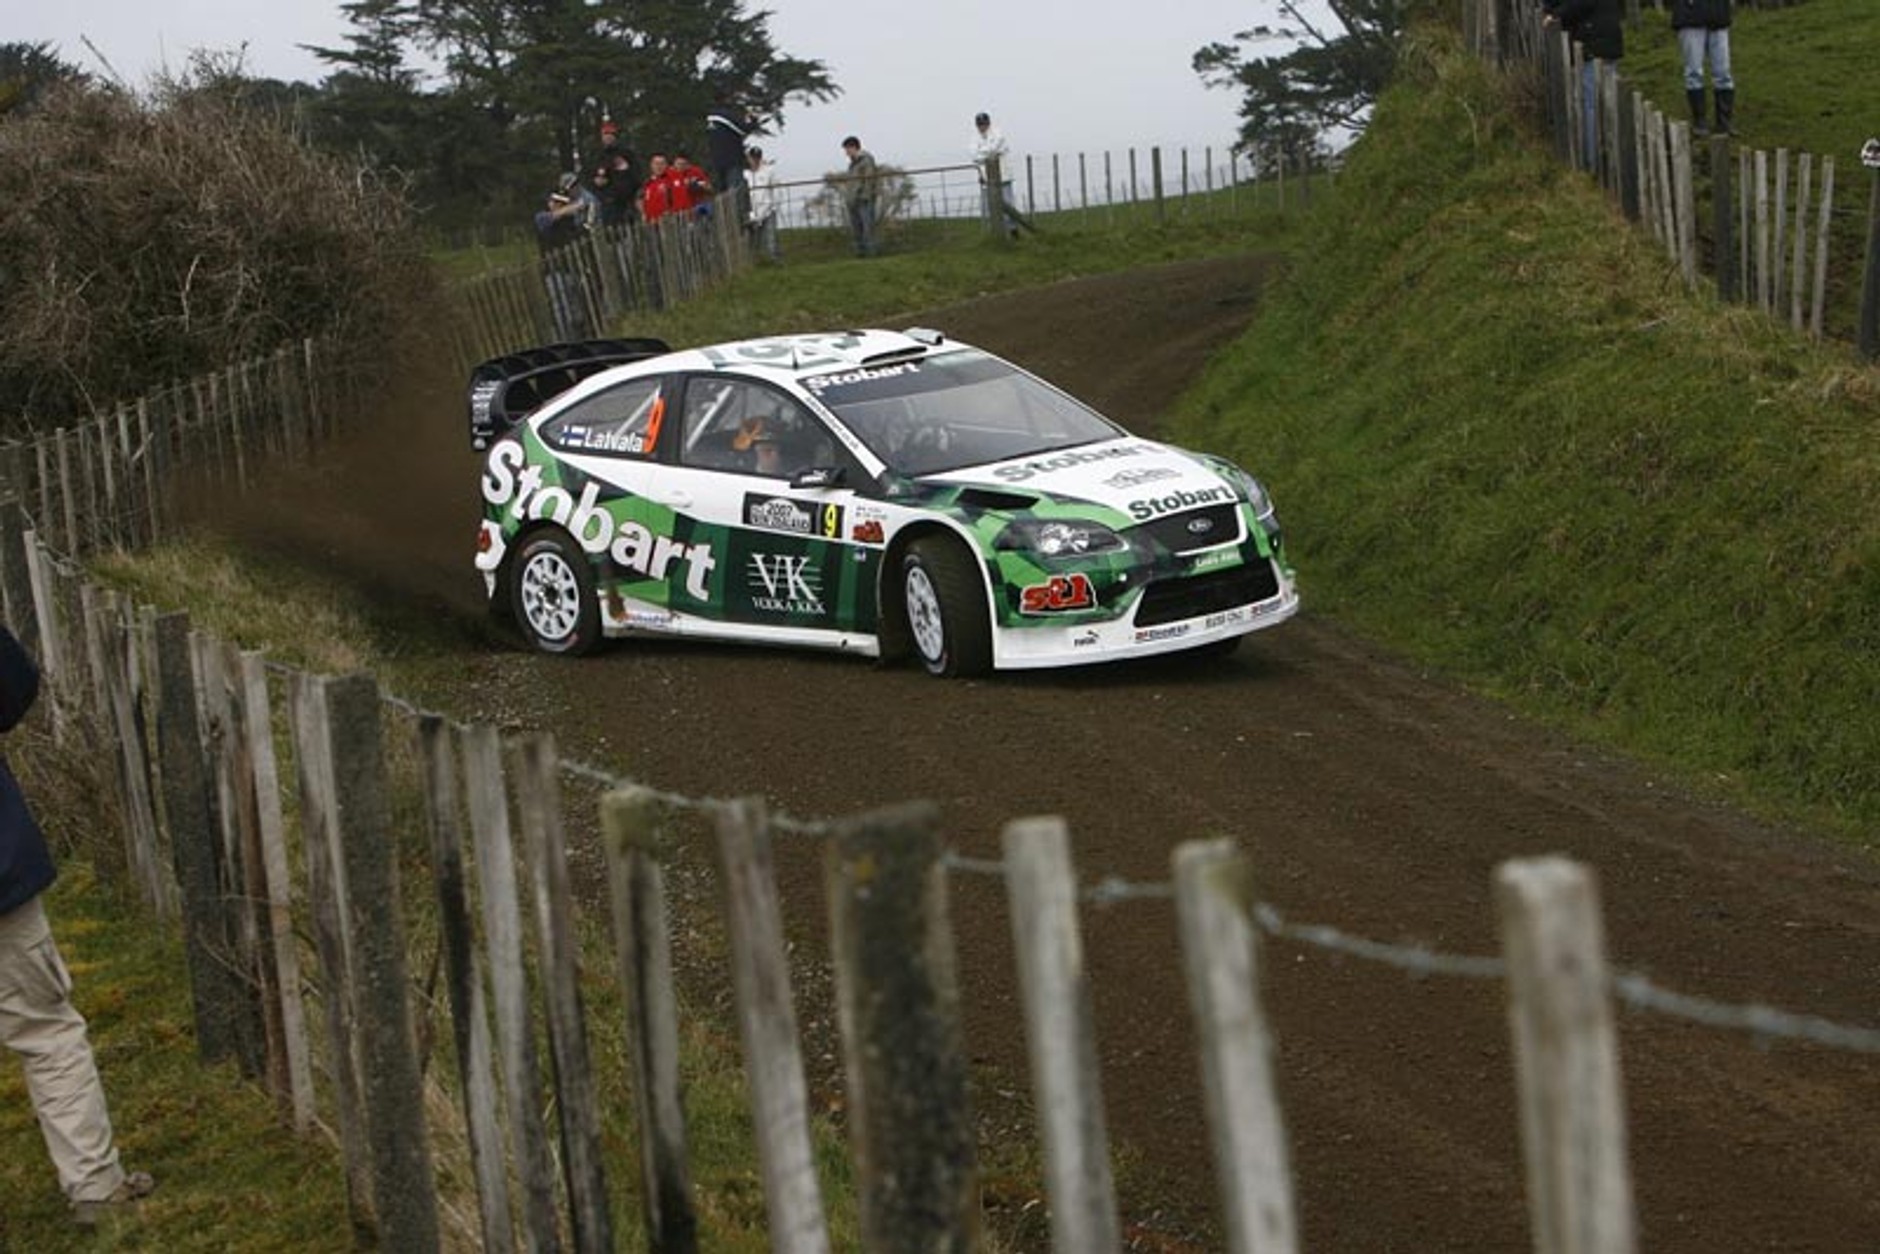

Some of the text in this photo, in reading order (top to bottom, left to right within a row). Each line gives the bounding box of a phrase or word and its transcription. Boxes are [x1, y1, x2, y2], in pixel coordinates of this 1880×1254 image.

[805, 361, 920, 388] Stobart
[994, 442, 1167, 482] Stobart
[481, 439, 716, 602] Stobart
[824, 503, 838, 538] 9
[1128, 483, 1236, 520] Stobart
[751, 552, 819, 602] VK
